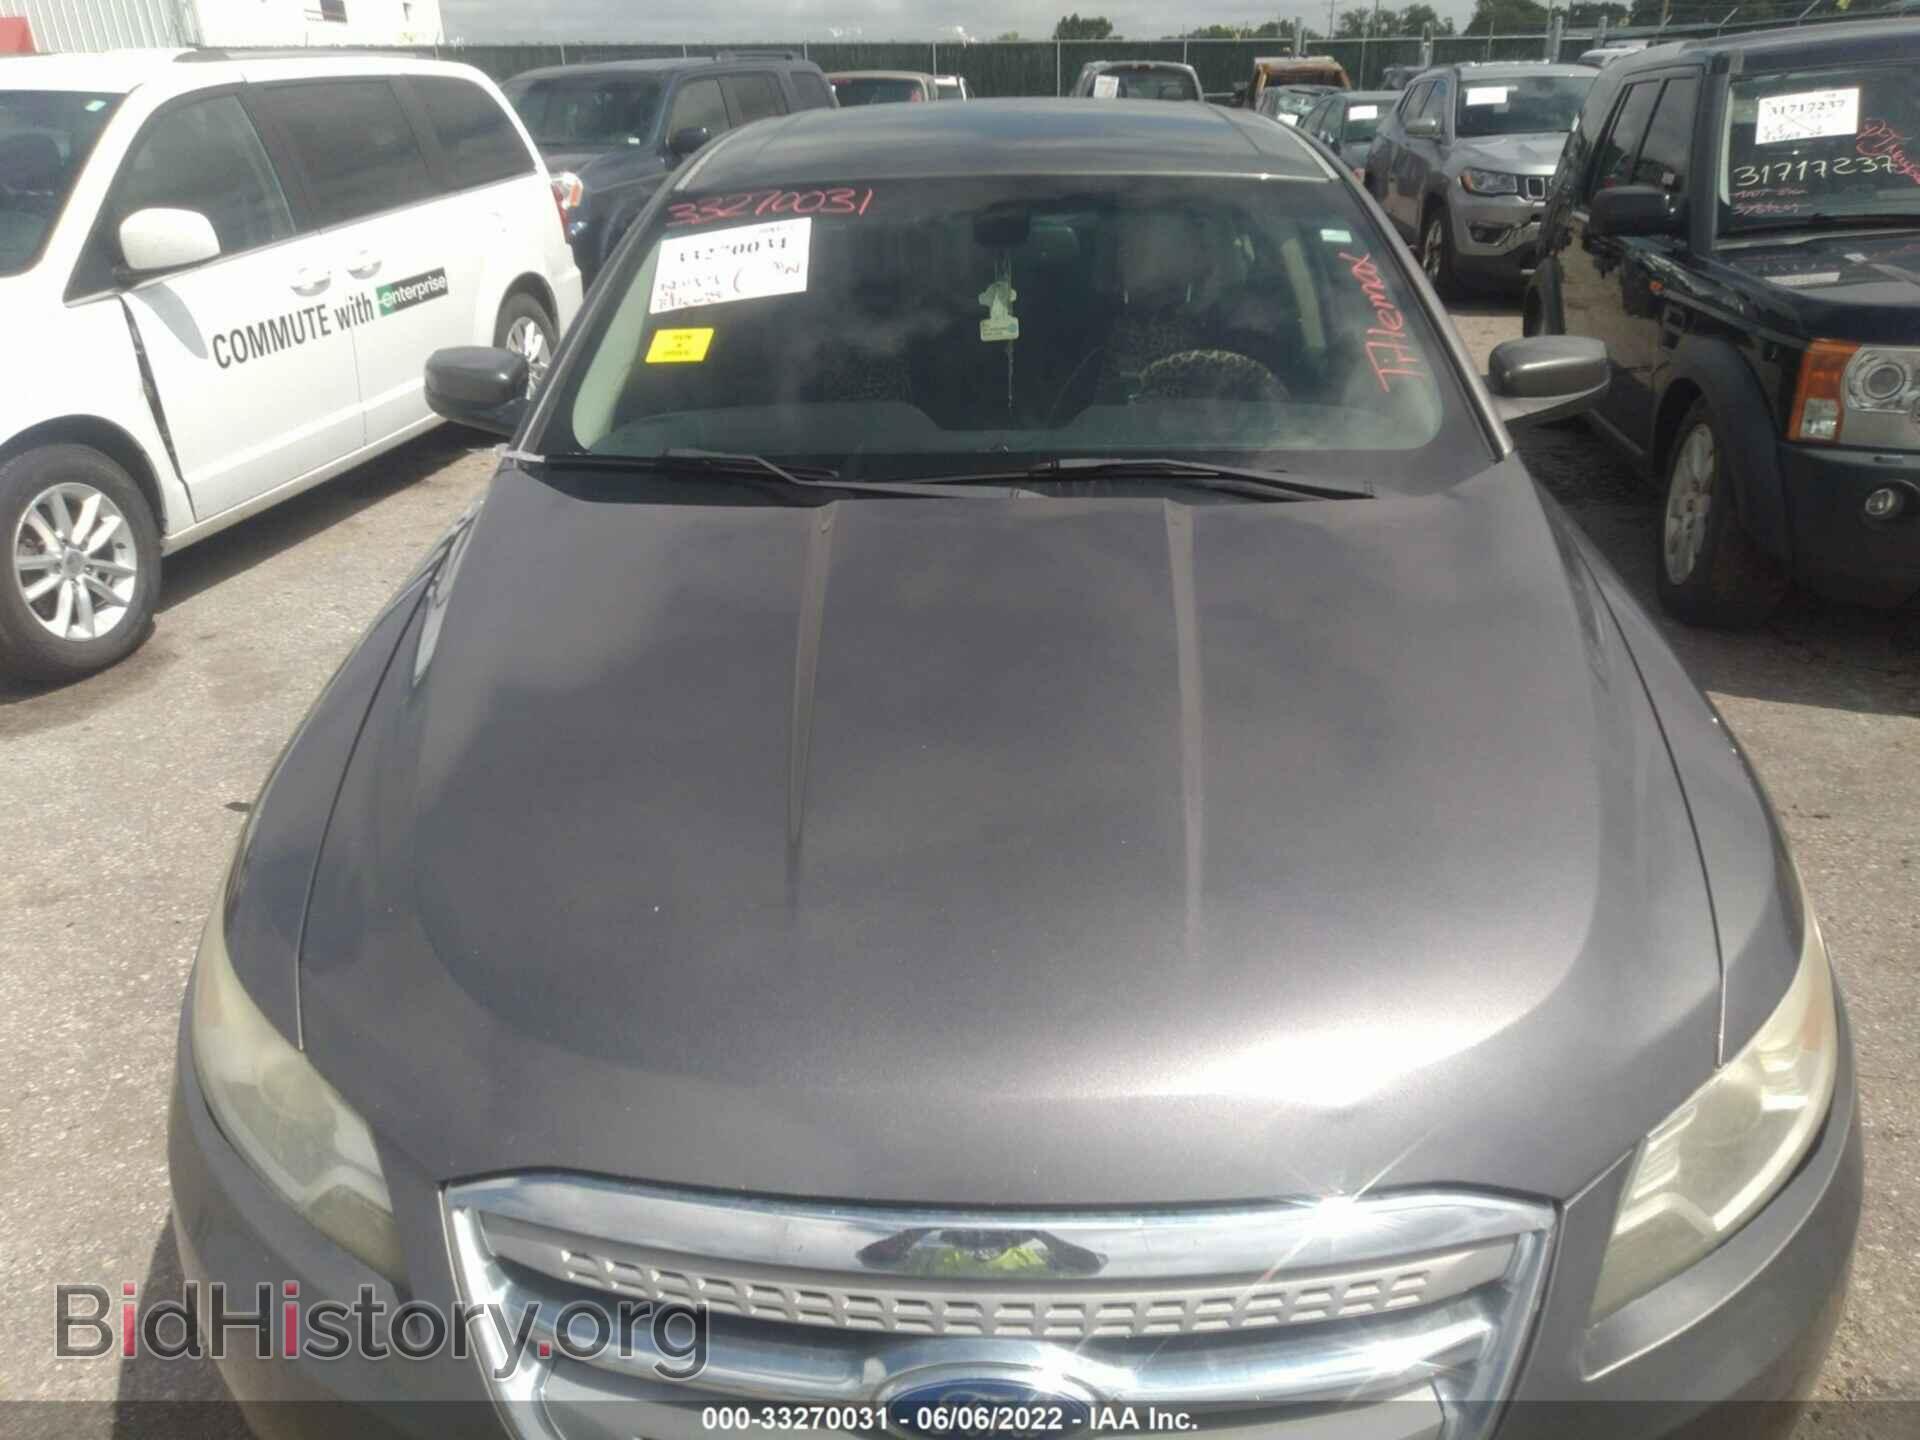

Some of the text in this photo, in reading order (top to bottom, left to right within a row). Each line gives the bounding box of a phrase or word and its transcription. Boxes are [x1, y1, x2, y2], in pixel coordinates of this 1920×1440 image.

[1734, 155, 1897, 187] 31717237
[665, 187, 873, 226] 33270031
[381, 275, 446, 308] enterprise
[212, 292, 375, 370] COMMUTE with
